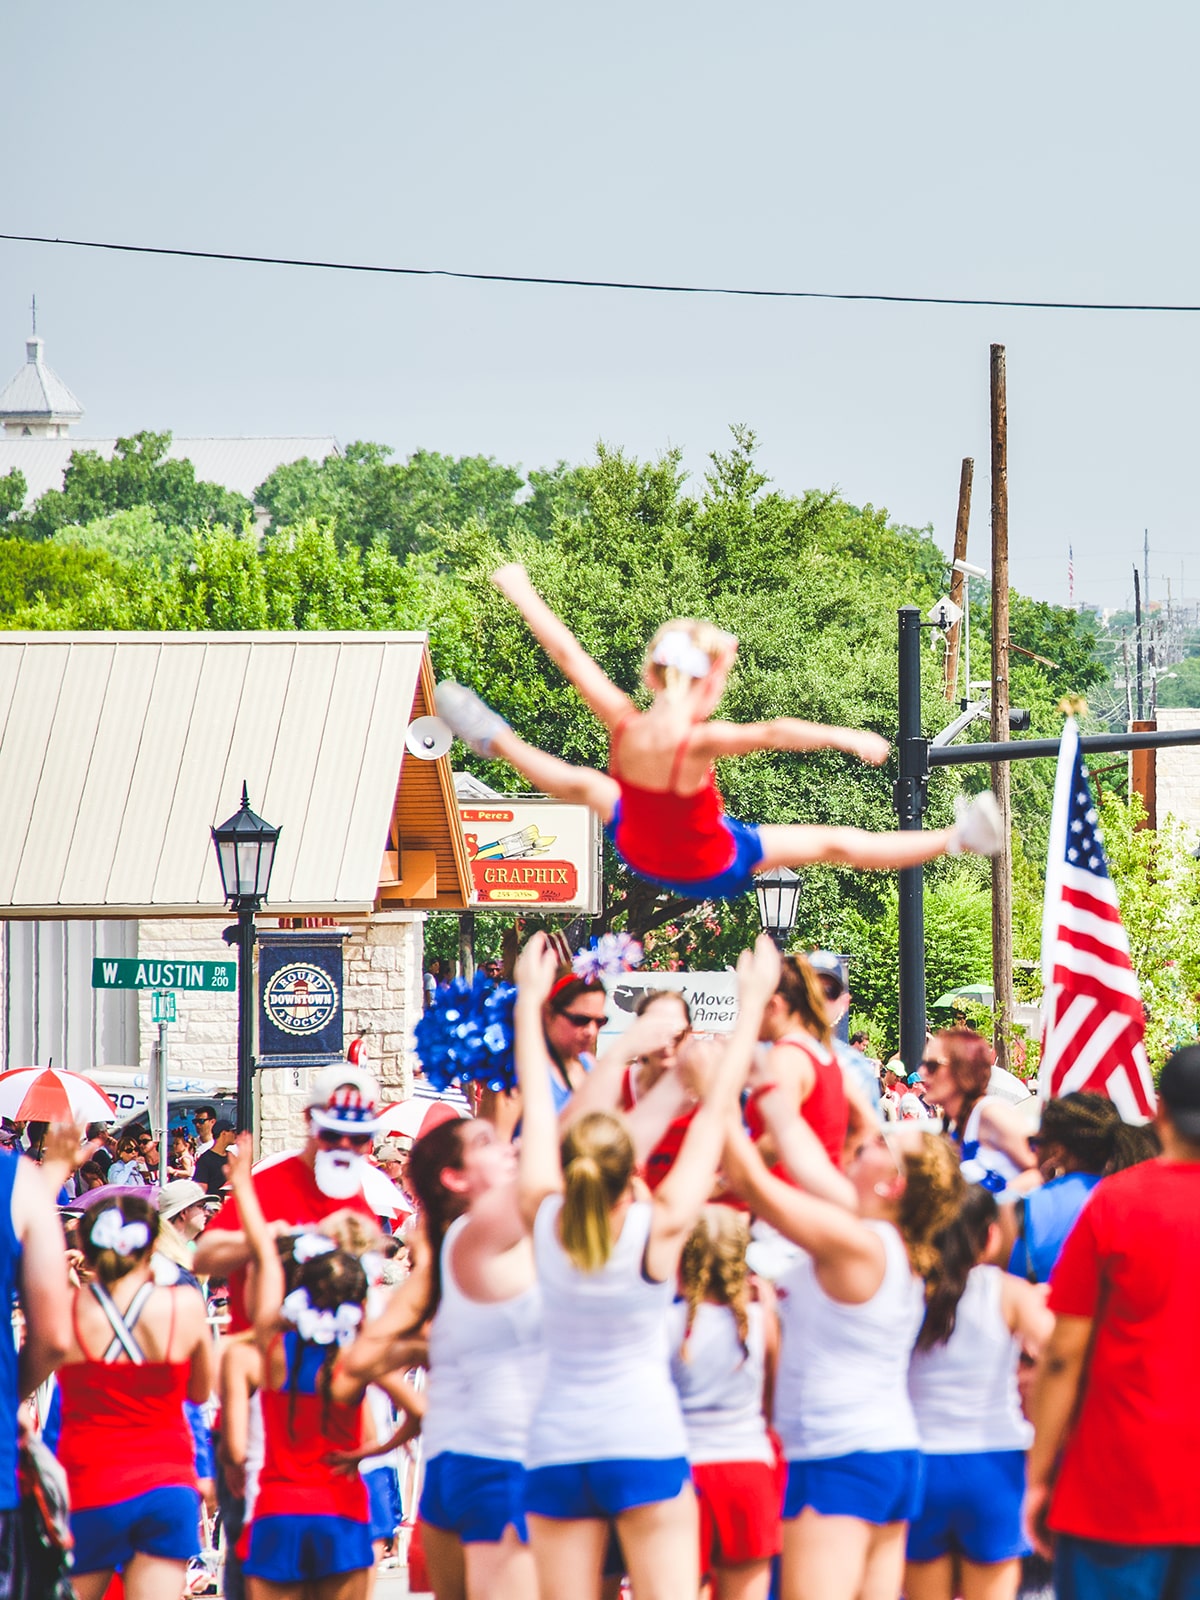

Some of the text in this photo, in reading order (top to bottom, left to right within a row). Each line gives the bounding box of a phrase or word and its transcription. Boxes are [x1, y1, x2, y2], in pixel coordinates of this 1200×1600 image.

[463, 811, 509, 819] L. Perez
[483, 867, 568, 884] GRAPHIX
[102, 962, 226, 987] W. AUSTIN DR
[278, 971, 323, 988] ROUND
[211, 976, 229, 987] 200
[270, 994, 332, 1005] DOWNTOWN
[284, 1014, 319, 1026] ROCK
